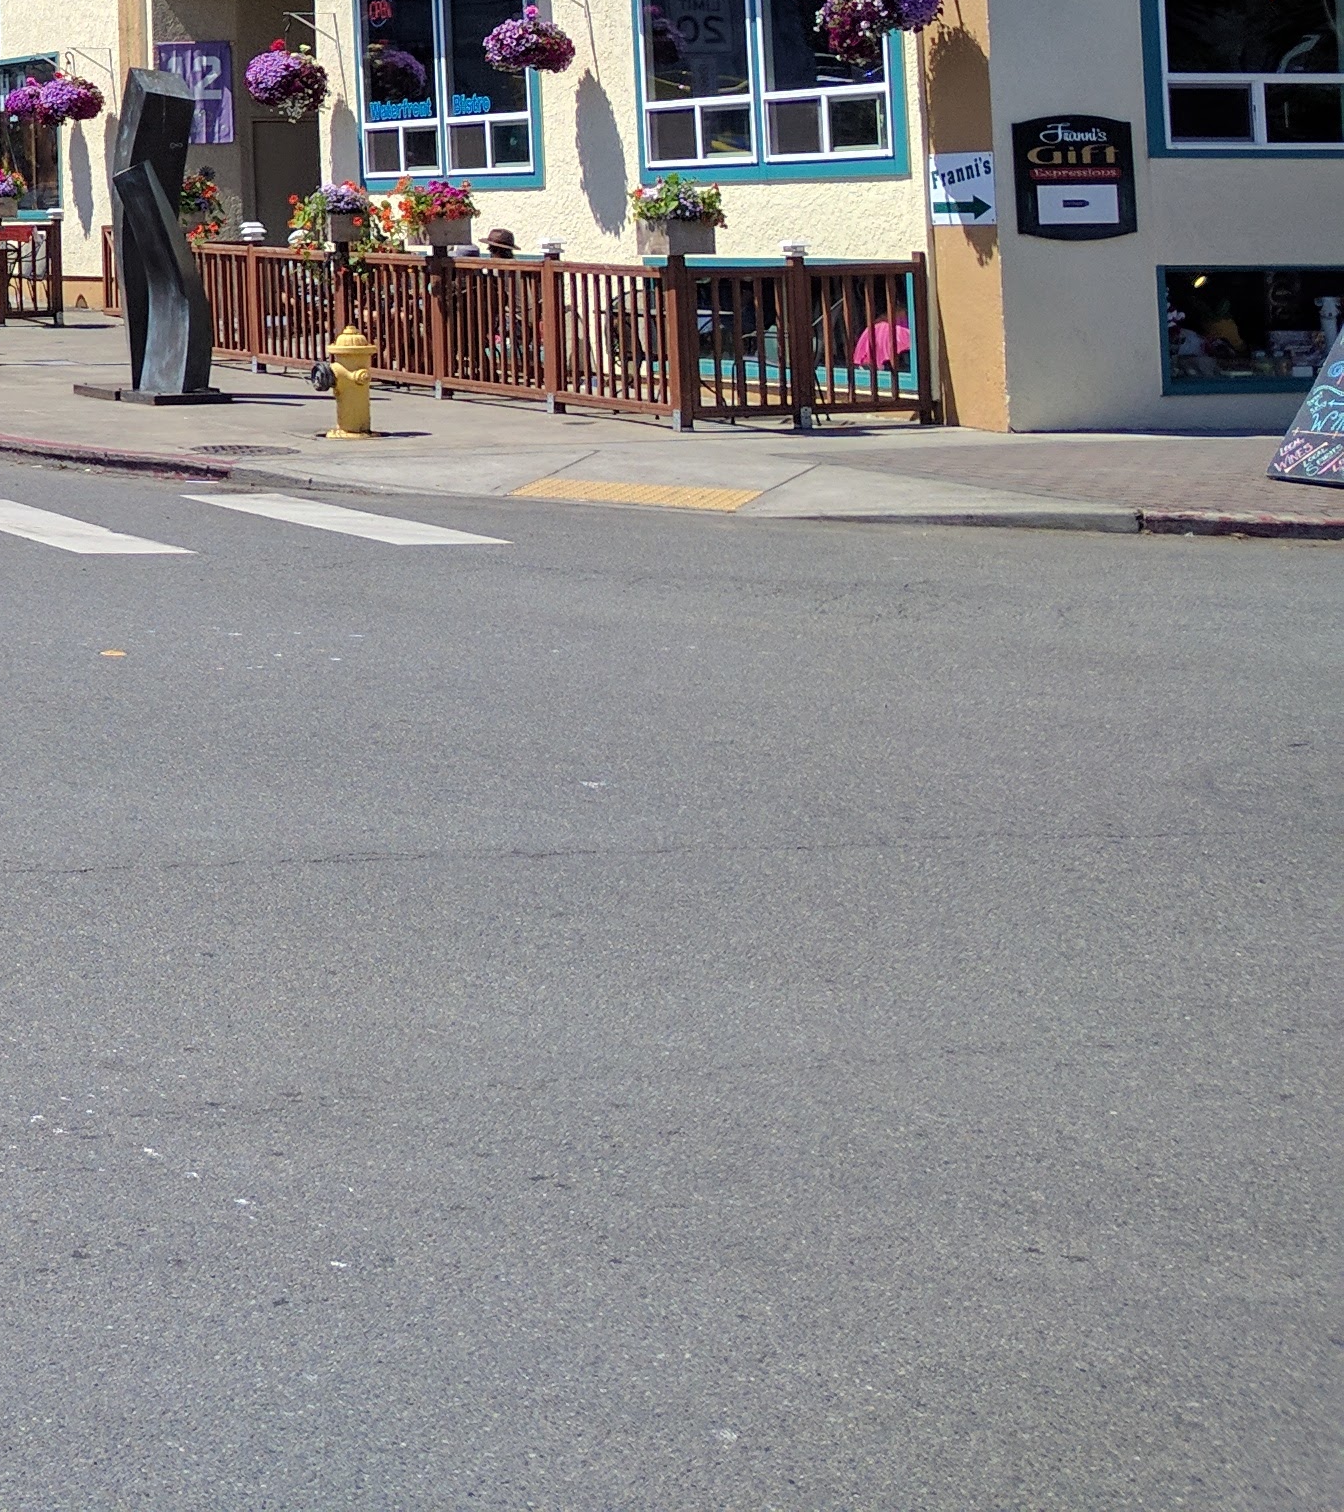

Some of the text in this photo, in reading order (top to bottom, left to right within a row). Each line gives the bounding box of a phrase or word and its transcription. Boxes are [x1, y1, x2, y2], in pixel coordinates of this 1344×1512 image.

[369, 93, 491, 121] Waterfront Bistro
[1039, 122, 1108, 144] Franni's
[1027, 144, 1119, 165] Gift
[931, 157, 992, 190] Franni's
[1033, 168, 1118, 180] Expressions
[1273, 442, 1313, 472] WINES
